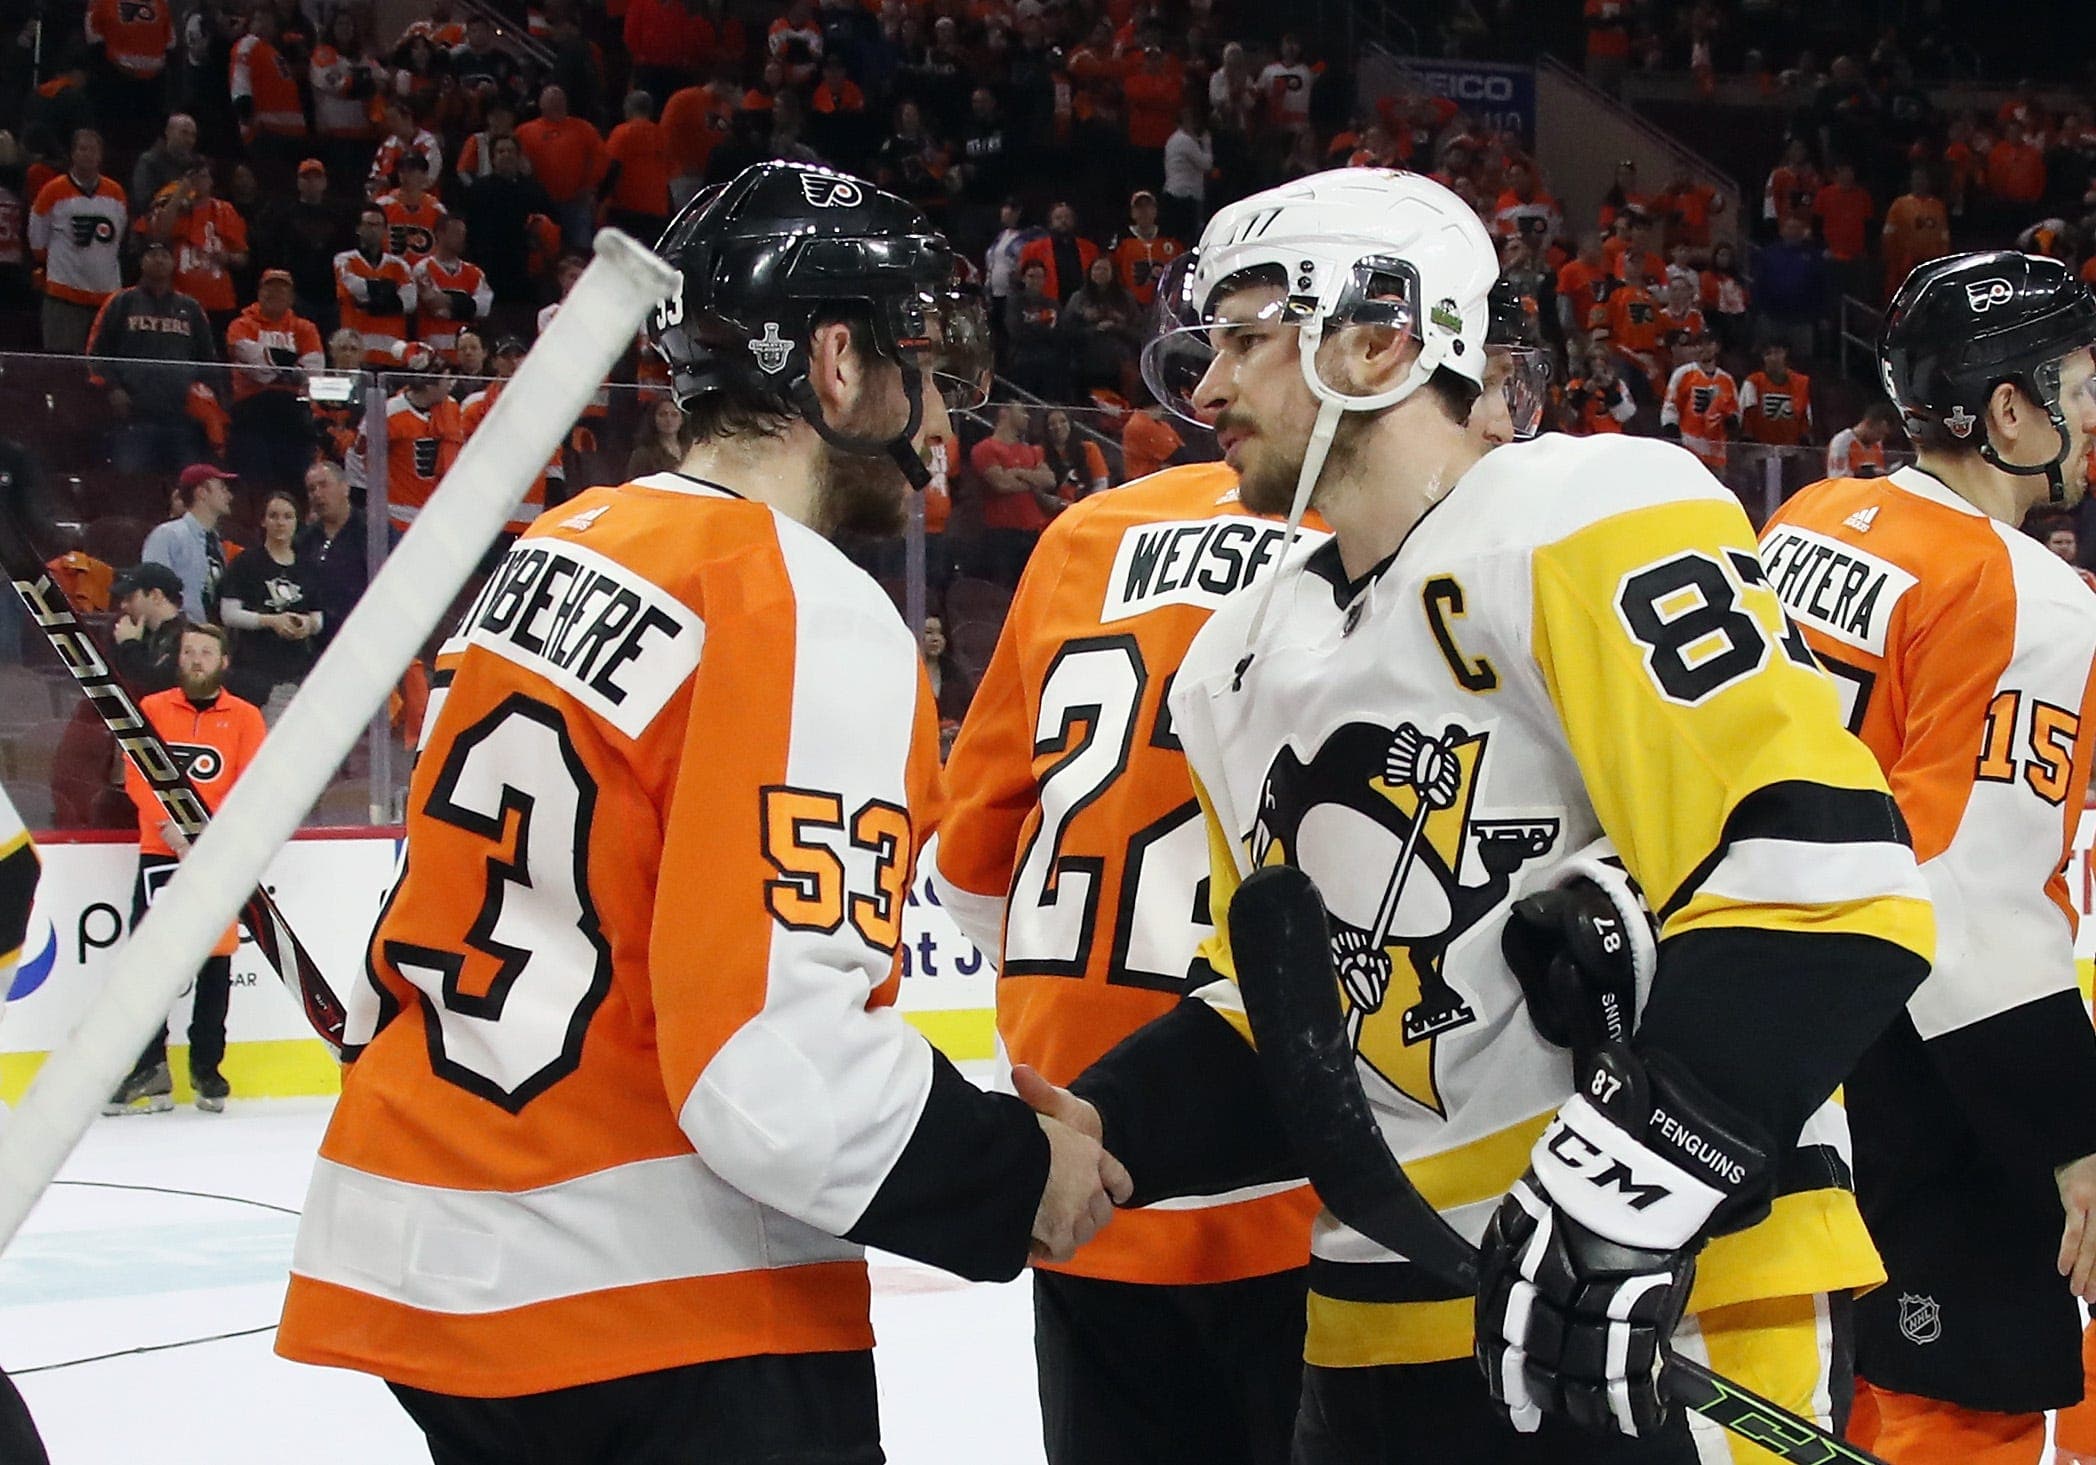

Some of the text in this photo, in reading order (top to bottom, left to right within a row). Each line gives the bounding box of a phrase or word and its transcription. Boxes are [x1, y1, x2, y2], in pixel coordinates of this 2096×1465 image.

[128, 315, 191, 336] FLYERS
[1419, 572, 1503, 697] C
[1973, 689, 2081, 807] 15
[364, 691, 614, 1117] 3
[759, 784, 912, 956] 53
[1592, 916, 1622, 954] 87
[1602, 991, 1624, 1043] UINS
[1590, 1068, 1623, 1105] 87
[1545, 1117, 1673, 1212] CM
[1649, 1107, 1746, 1185] PENGUINS
[1909, 1308, 1932, 1331] NHL
